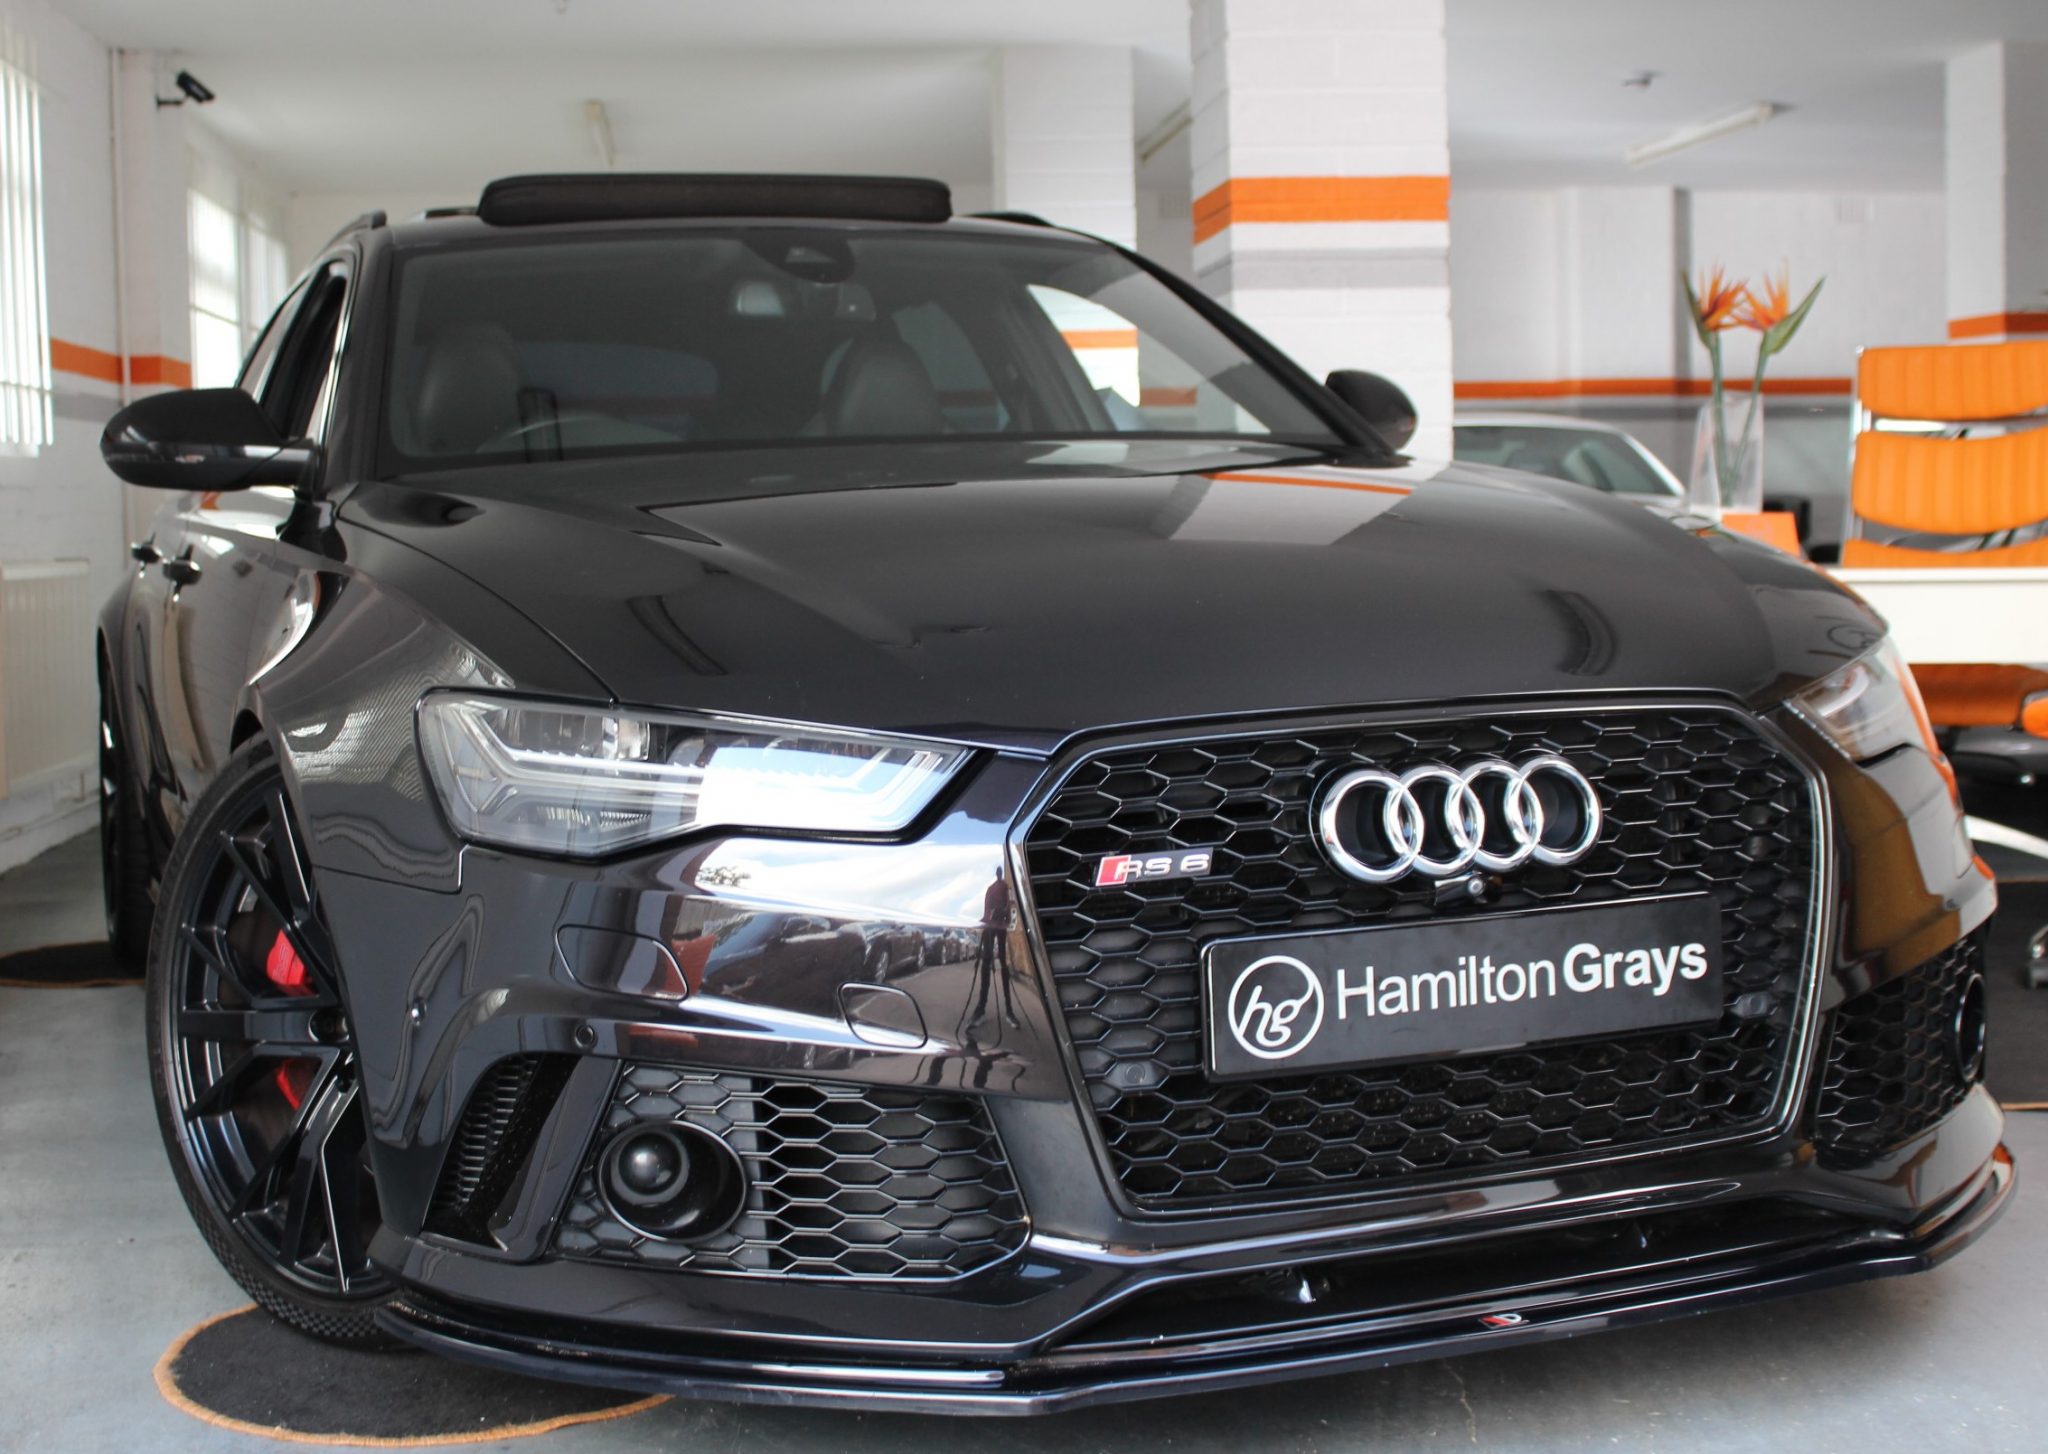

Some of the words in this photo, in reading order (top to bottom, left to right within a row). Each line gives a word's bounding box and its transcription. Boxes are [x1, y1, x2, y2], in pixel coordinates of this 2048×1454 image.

[1113, 856, 1173, 882] RS
[1180, 852, 1211, 874] 6
[1236, 975, 1315, 1049] hg
